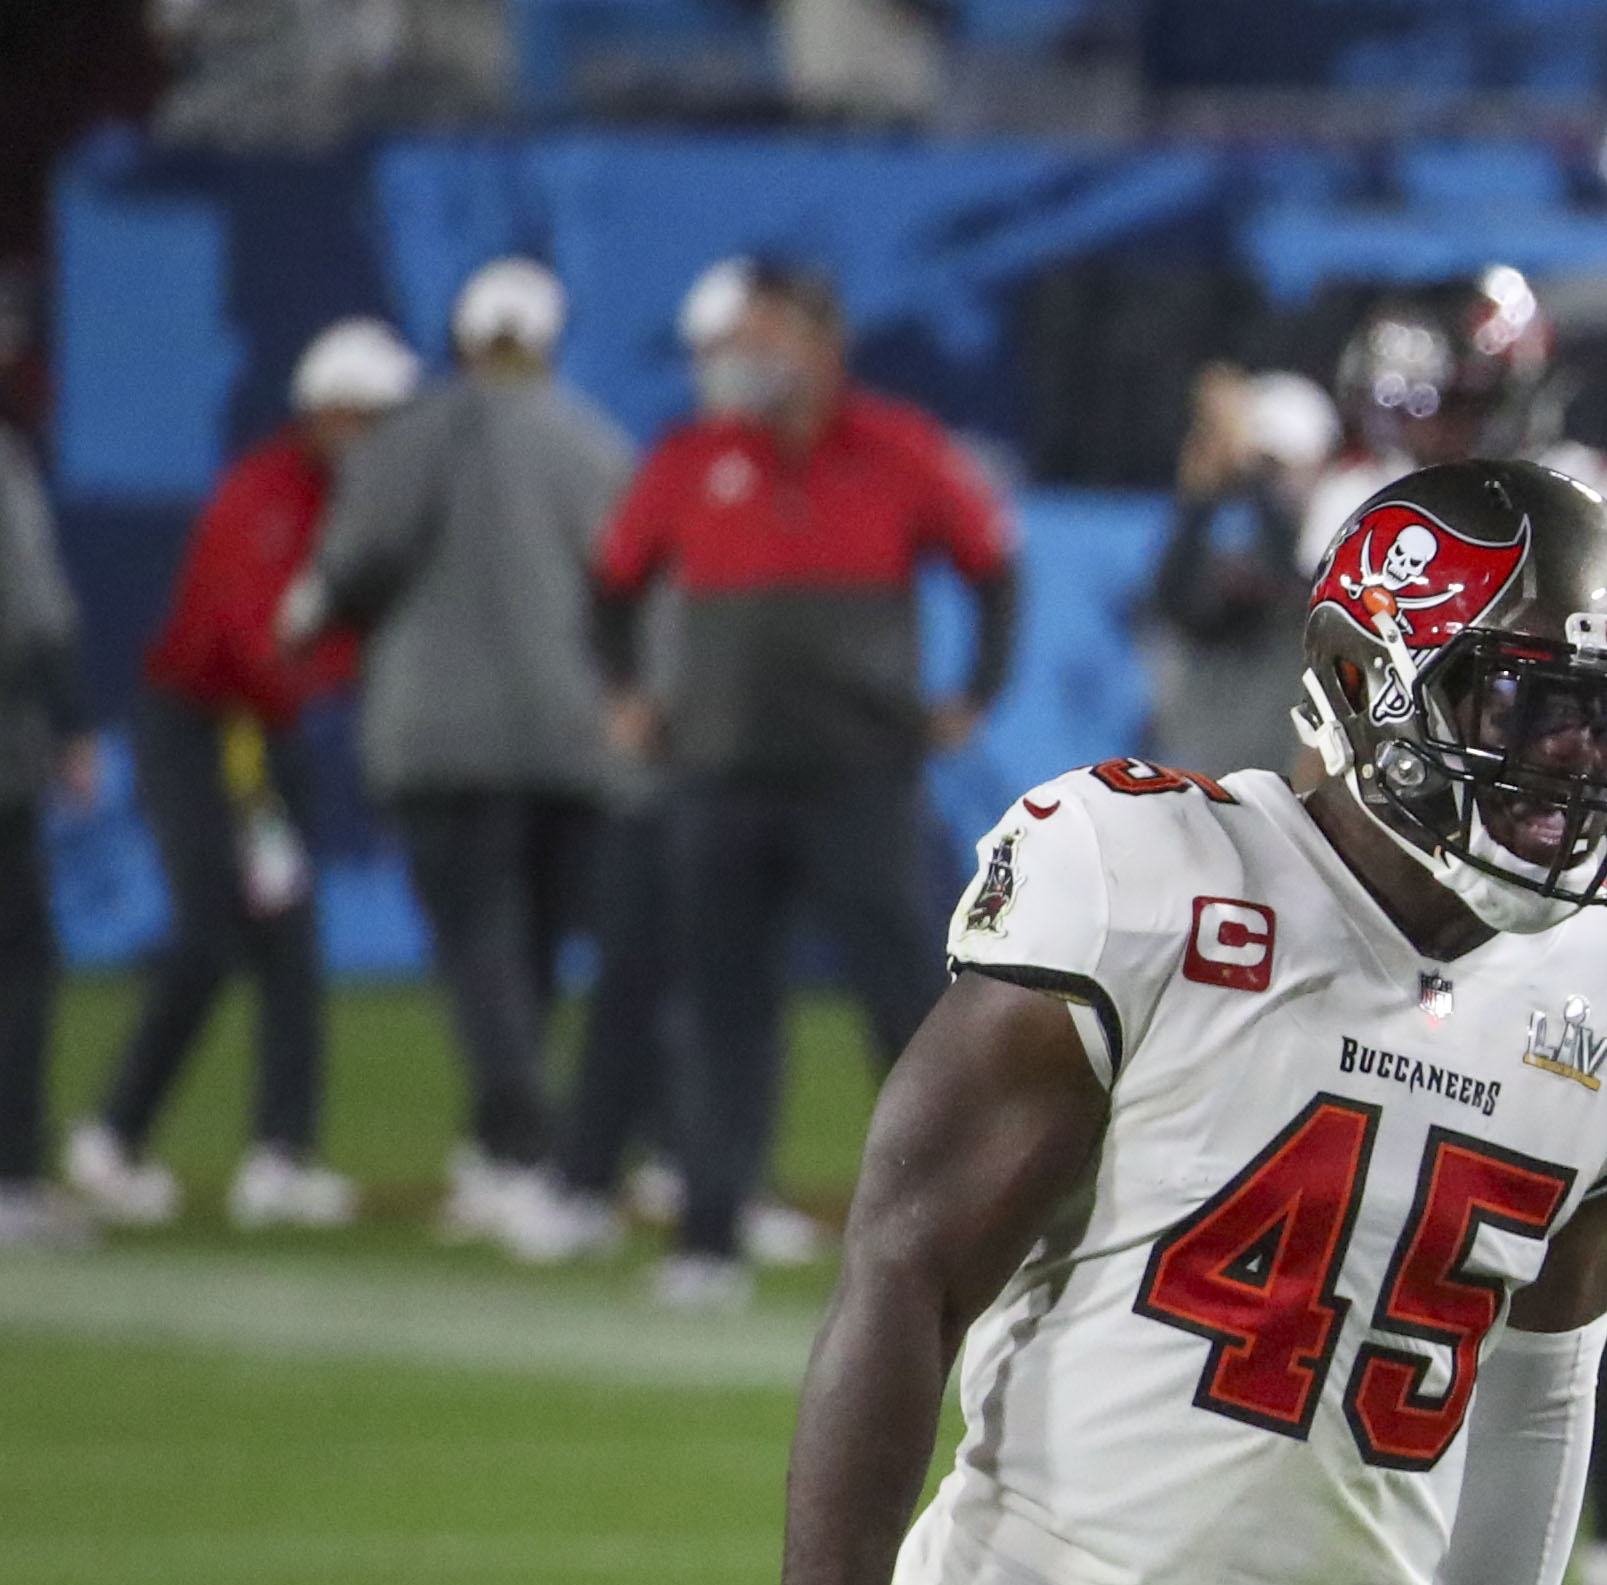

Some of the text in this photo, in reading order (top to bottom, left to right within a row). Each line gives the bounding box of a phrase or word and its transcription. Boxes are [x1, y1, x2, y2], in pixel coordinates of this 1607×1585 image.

[1196, 902, 1269, 967] C
[1340, 1035, 1502, 1117] BUCCANEERS
[1132, 1091, 1578, 1473] 45
